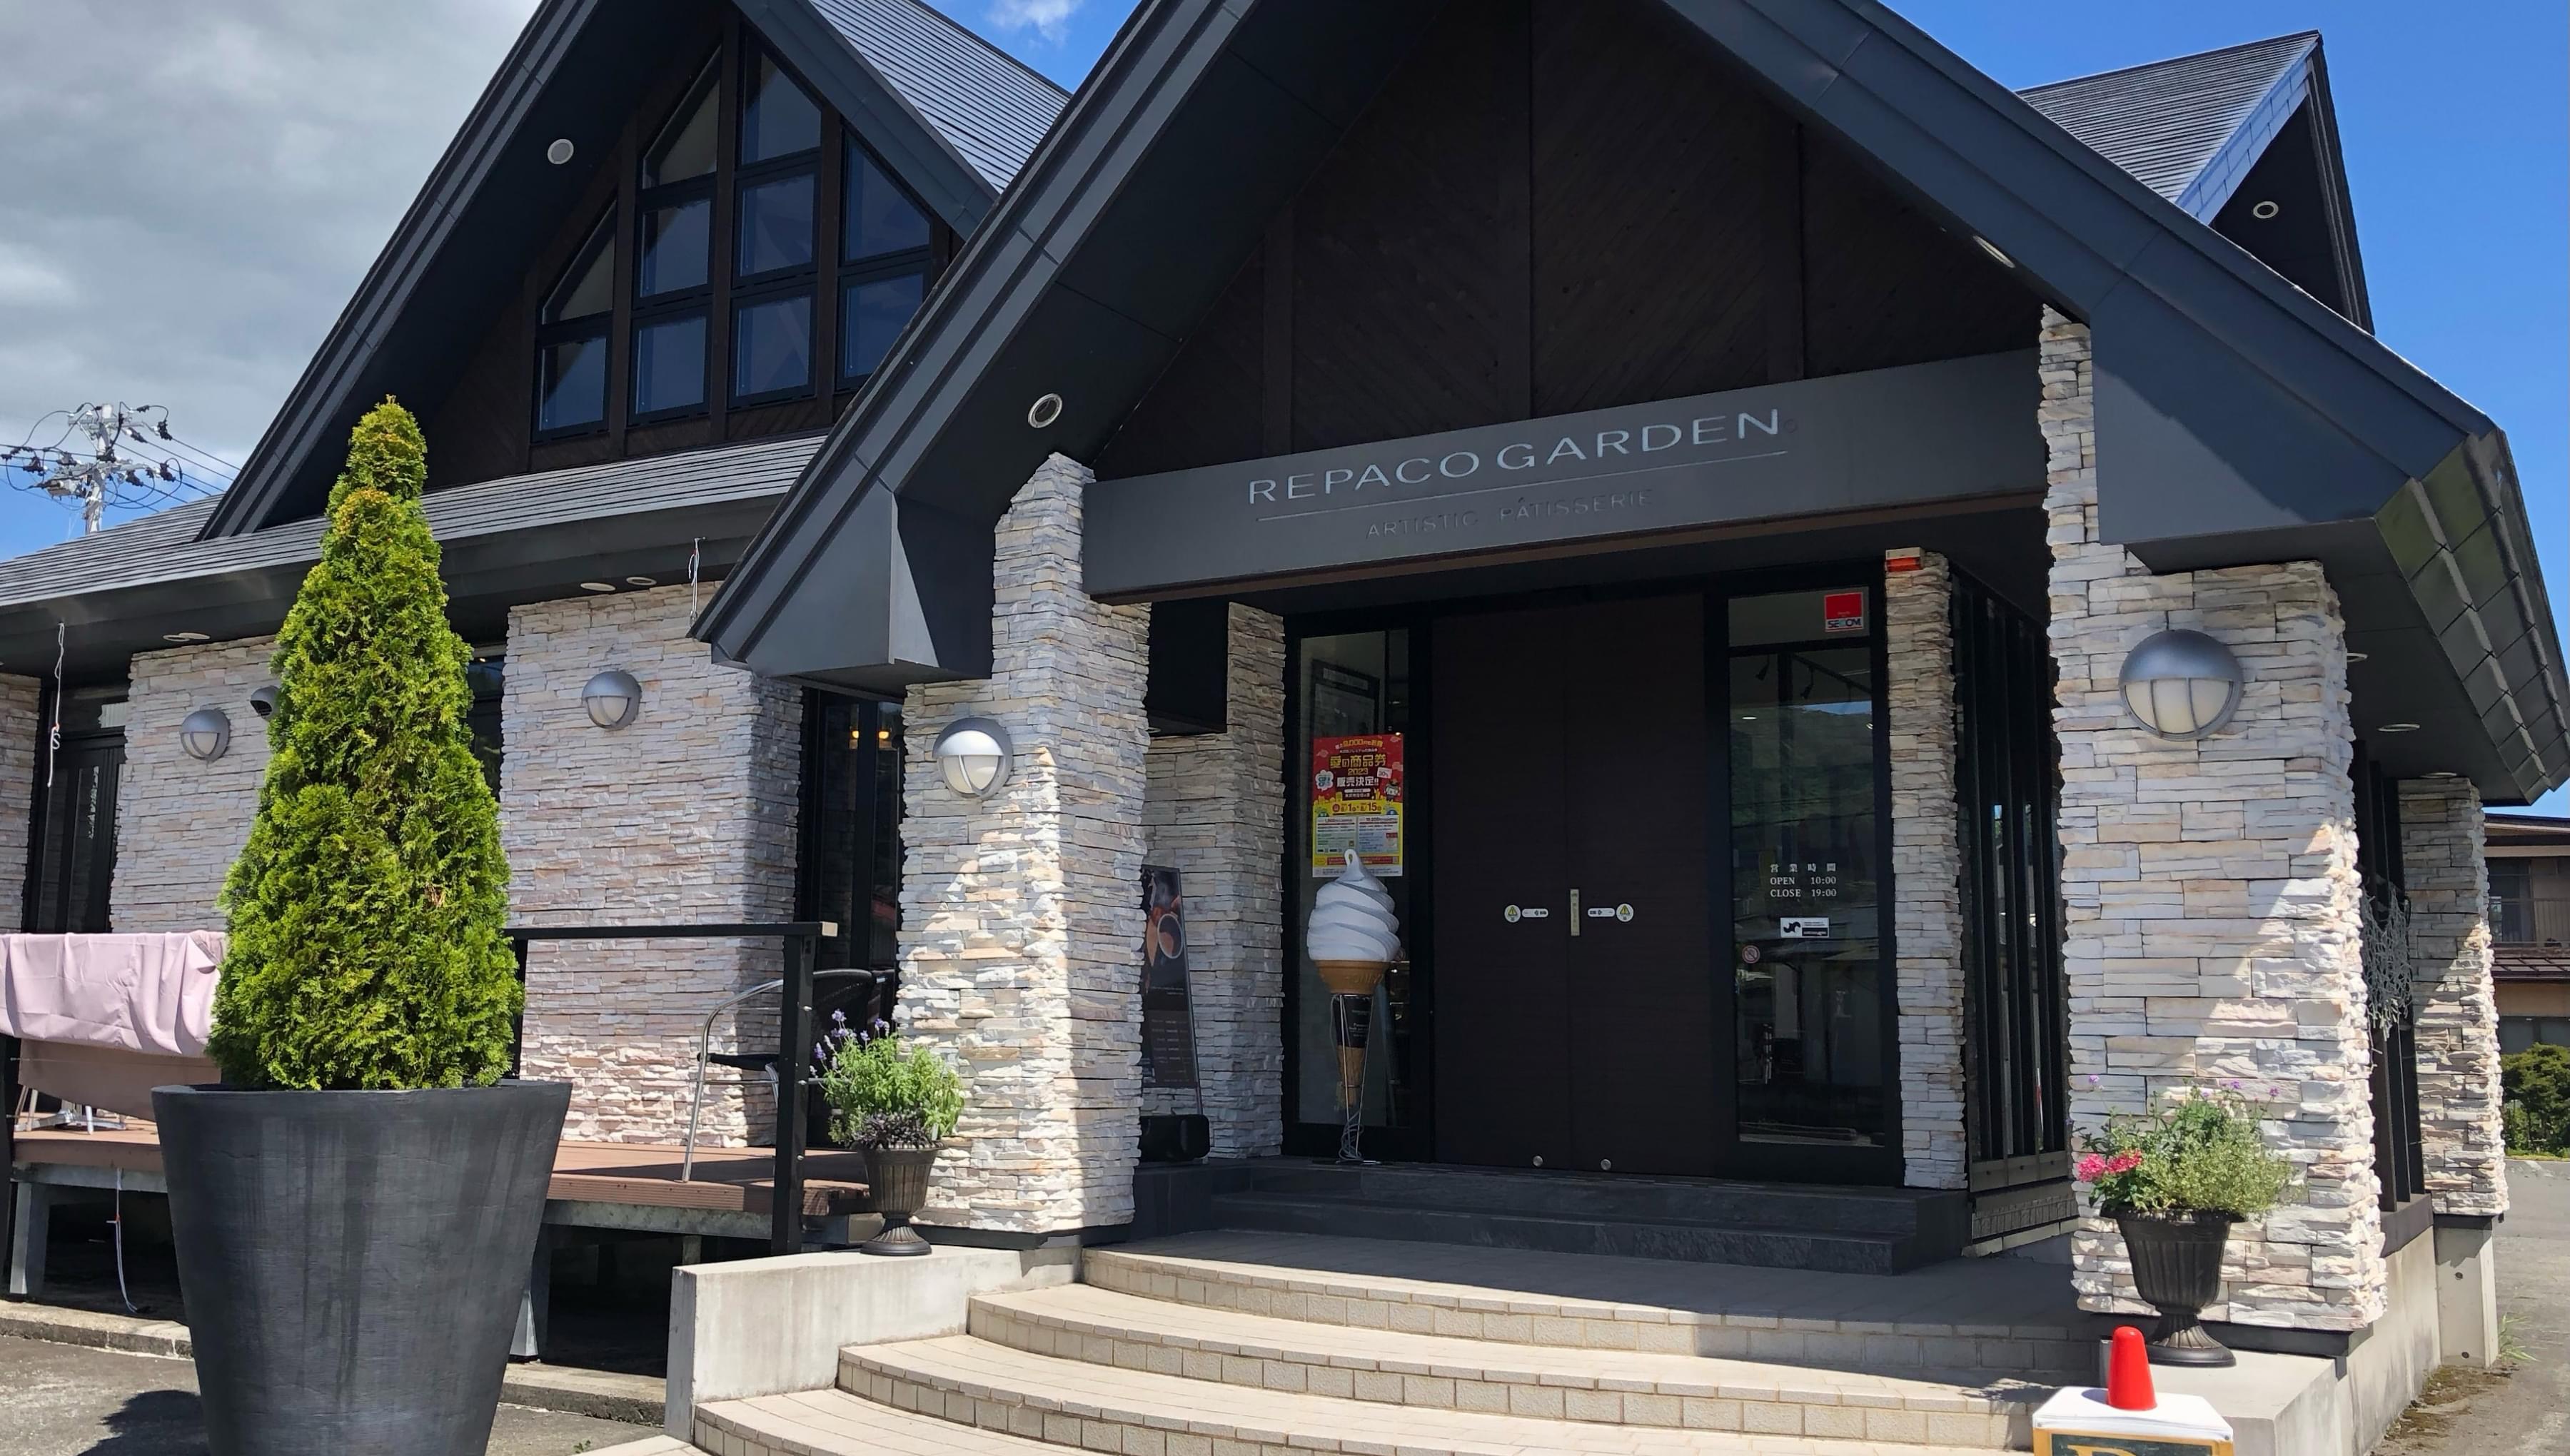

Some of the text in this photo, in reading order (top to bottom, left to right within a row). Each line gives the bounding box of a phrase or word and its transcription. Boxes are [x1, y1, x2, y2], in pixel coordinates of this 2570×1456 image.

[1249, 408, 1778, 505] REPACO GARDEN
[1366, 488, 1653, 540] ARTISTIC PÂTISSERIE
[1329, 754, 1386, 769] 愛の商品券
[1770, 876, 1837, 885] OPEN 10:00
[1770, 888, 1837, 897] CLOSE 19:00
